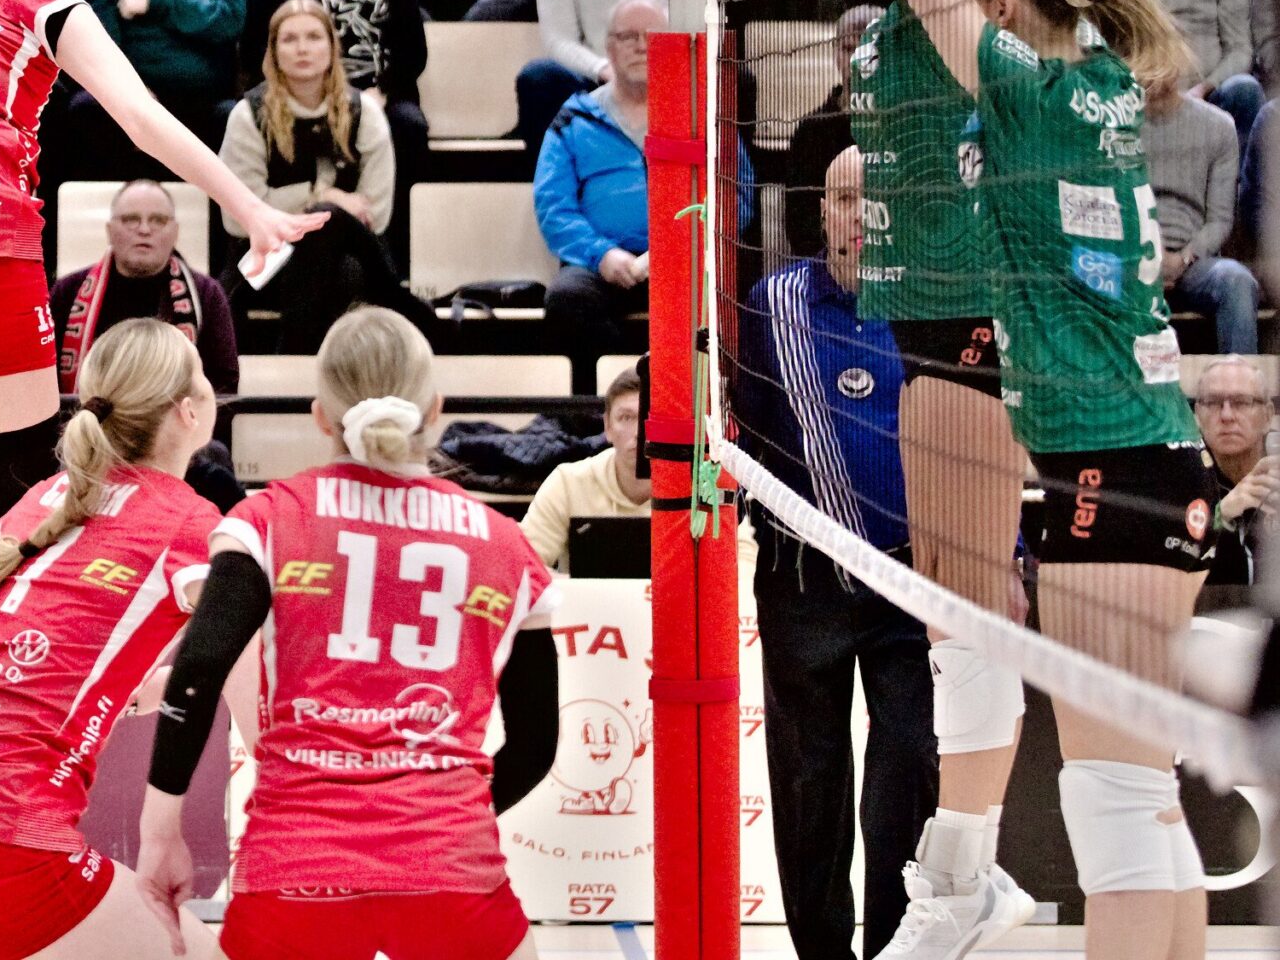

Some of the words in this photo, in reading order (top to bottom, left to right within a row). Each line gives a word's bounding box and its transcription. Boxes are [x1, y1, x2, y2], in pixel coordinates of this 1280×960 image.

[316, 477, 490, 541] KUKKONEN
[1070, 467, 1103, 539] rena
[326, 530, 470, 673] 13
[551, 624, 628, 659] TA
[285, 748, 436, 771] VIHER-INKA
[568, 883, 618, 895] RATA
[569, 897, 615, 915] 57
